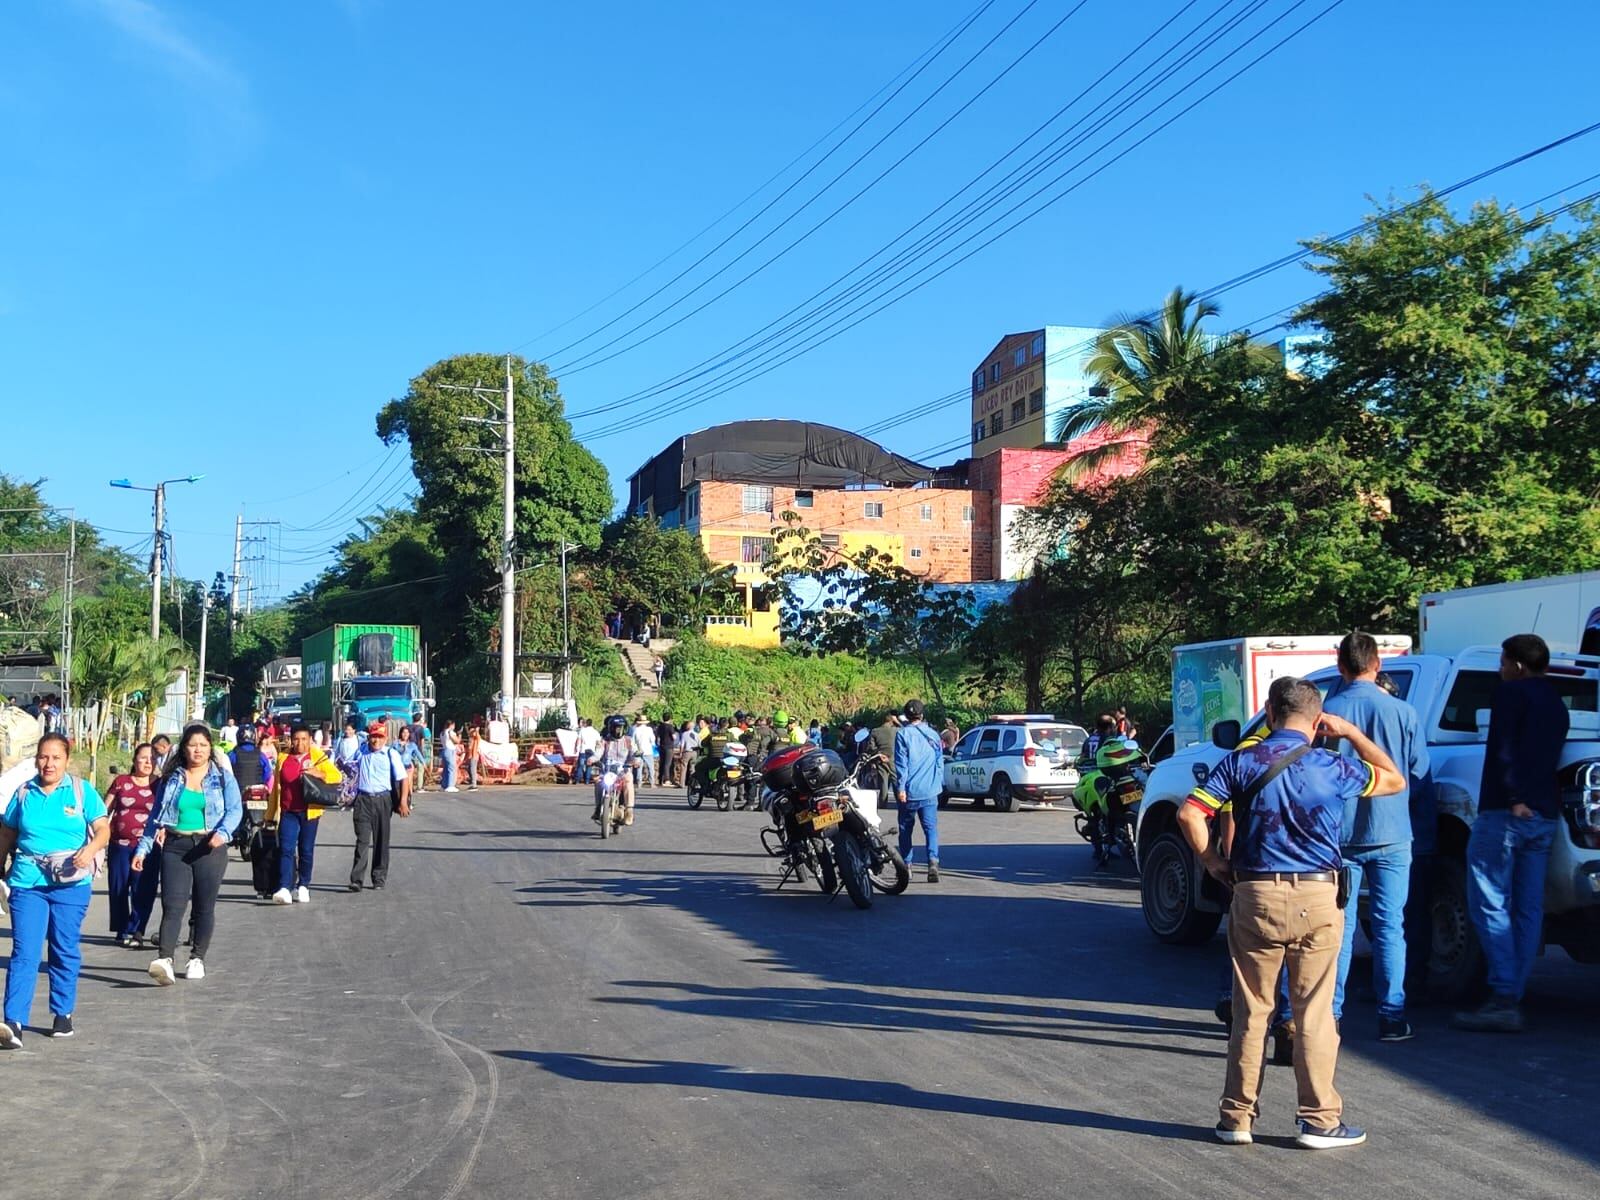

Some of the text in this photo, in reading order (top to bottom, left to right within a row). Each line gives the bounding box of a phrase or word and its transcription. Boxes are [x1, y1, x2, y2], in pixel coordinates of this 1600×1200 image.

[1000, 380, 1014, 404] REY
[1015, 371, 1036, 397] DAVID
[1204, 695, 1221, 714] LECHE
[951, 766, 986, 776] POLICIA
